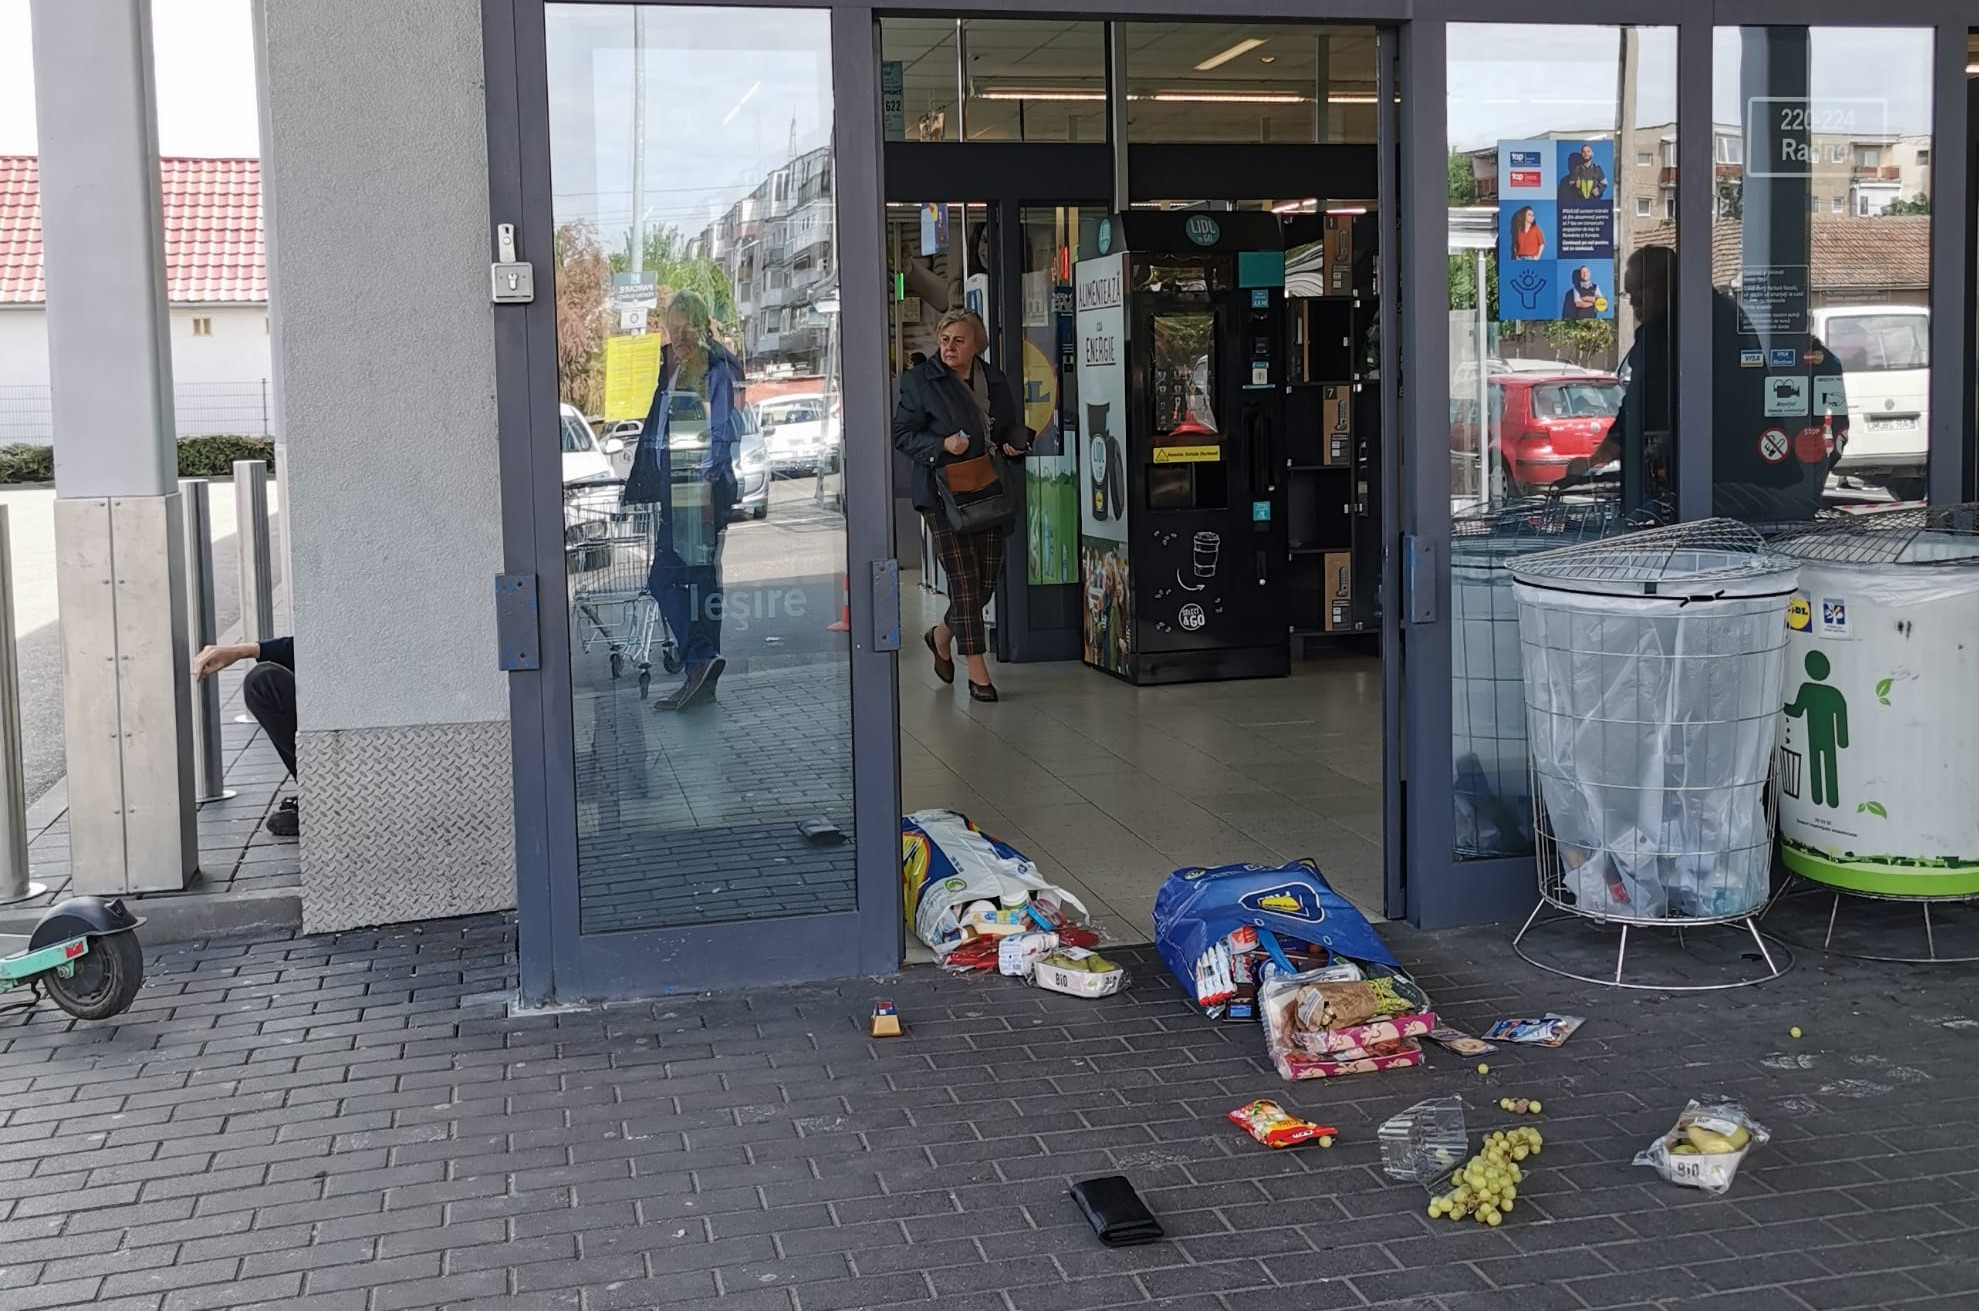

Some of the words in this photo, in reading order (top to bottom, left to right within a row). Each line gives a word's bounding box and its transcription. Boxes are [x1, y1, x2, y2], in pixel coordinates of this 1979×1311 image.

[885, 100, 901, 112] 622
[1190, 219, 1216, 234] LIDL
[1078, 270, 1121, 309] ALIMENTEAZĂ
[1086, 336, 1115, 363] ENERGIE
[1327, 388, 1334, 398] 7
[1803, 428, 1821, 436] STOP
[1182, 608, 1200, 616] SELECT
